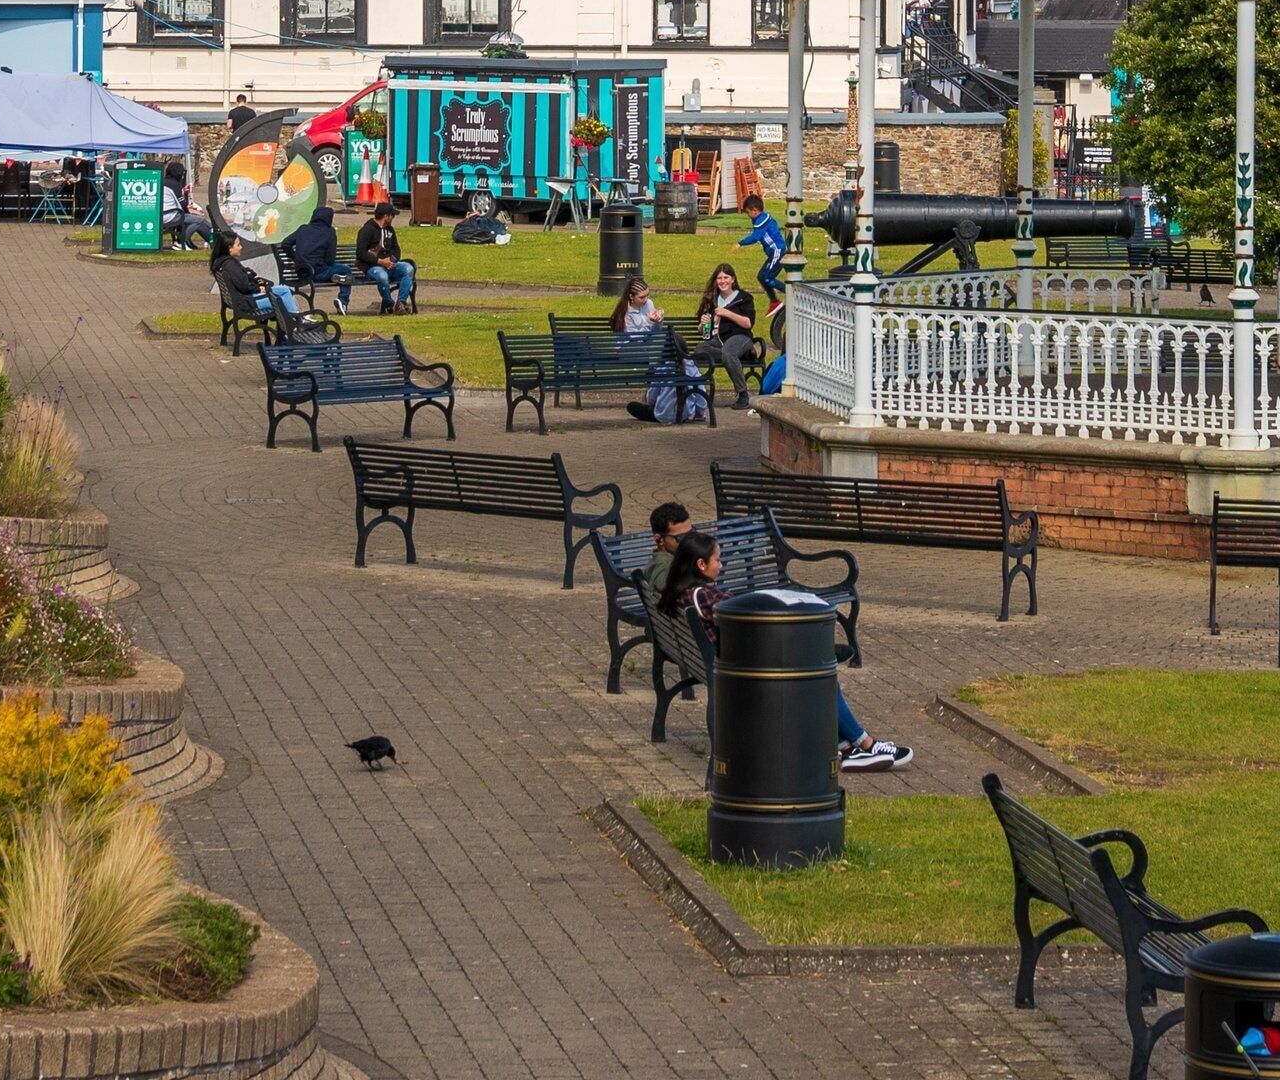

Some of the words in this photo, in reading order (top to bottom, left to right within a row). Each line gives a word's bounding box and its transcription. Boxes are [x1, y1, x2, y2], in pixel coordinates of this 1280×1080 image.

[465, 108, 486, 126] Truly
[626, 93, 640, 160] Scrumptious
[451, 124, 499, 146] Scrumptious
[351, 141, 380, 152] YOU
[121, 182, 158, 196] YOU
[475, 177, 487, 187] All
